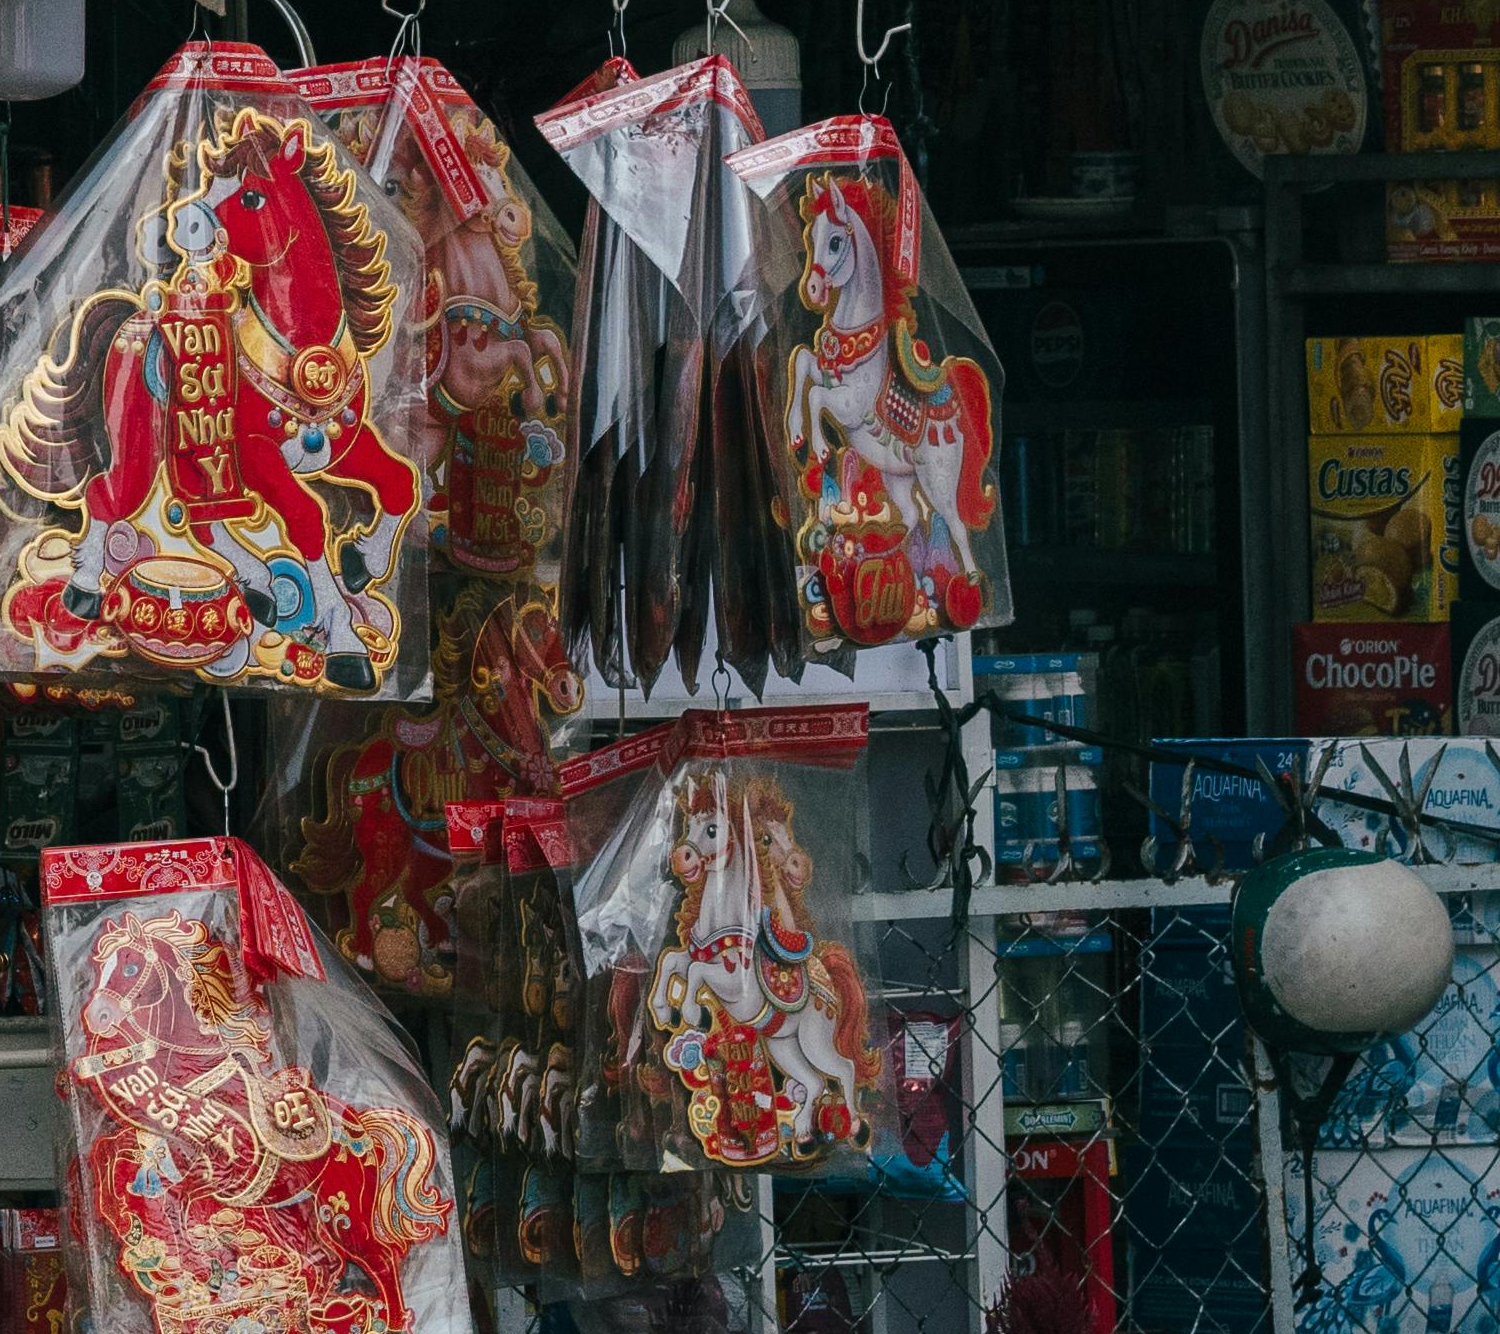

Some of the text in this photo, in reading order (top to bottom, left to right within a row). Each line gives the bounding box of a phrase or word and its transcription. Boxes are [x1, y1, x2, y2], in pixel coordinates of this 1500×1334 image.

[161, 321, 222, 365] Vạn
[180, 361, 227, 406] Sự
[177, 406, 235, 450] Như
[1318, 458, 1412, 500] Custas
[1355, 639, 1400, 655] ORION
[1305, 652, 1437, 690] ChocoPie
[1192, 773, 1266, 802] AQUAFINA
[1425, 787, 1493, 809] AQUAFINA
[109, 1065, 159, 1107] Vạn
[1404, 1197, 1475, 1217] AQUAFINA
